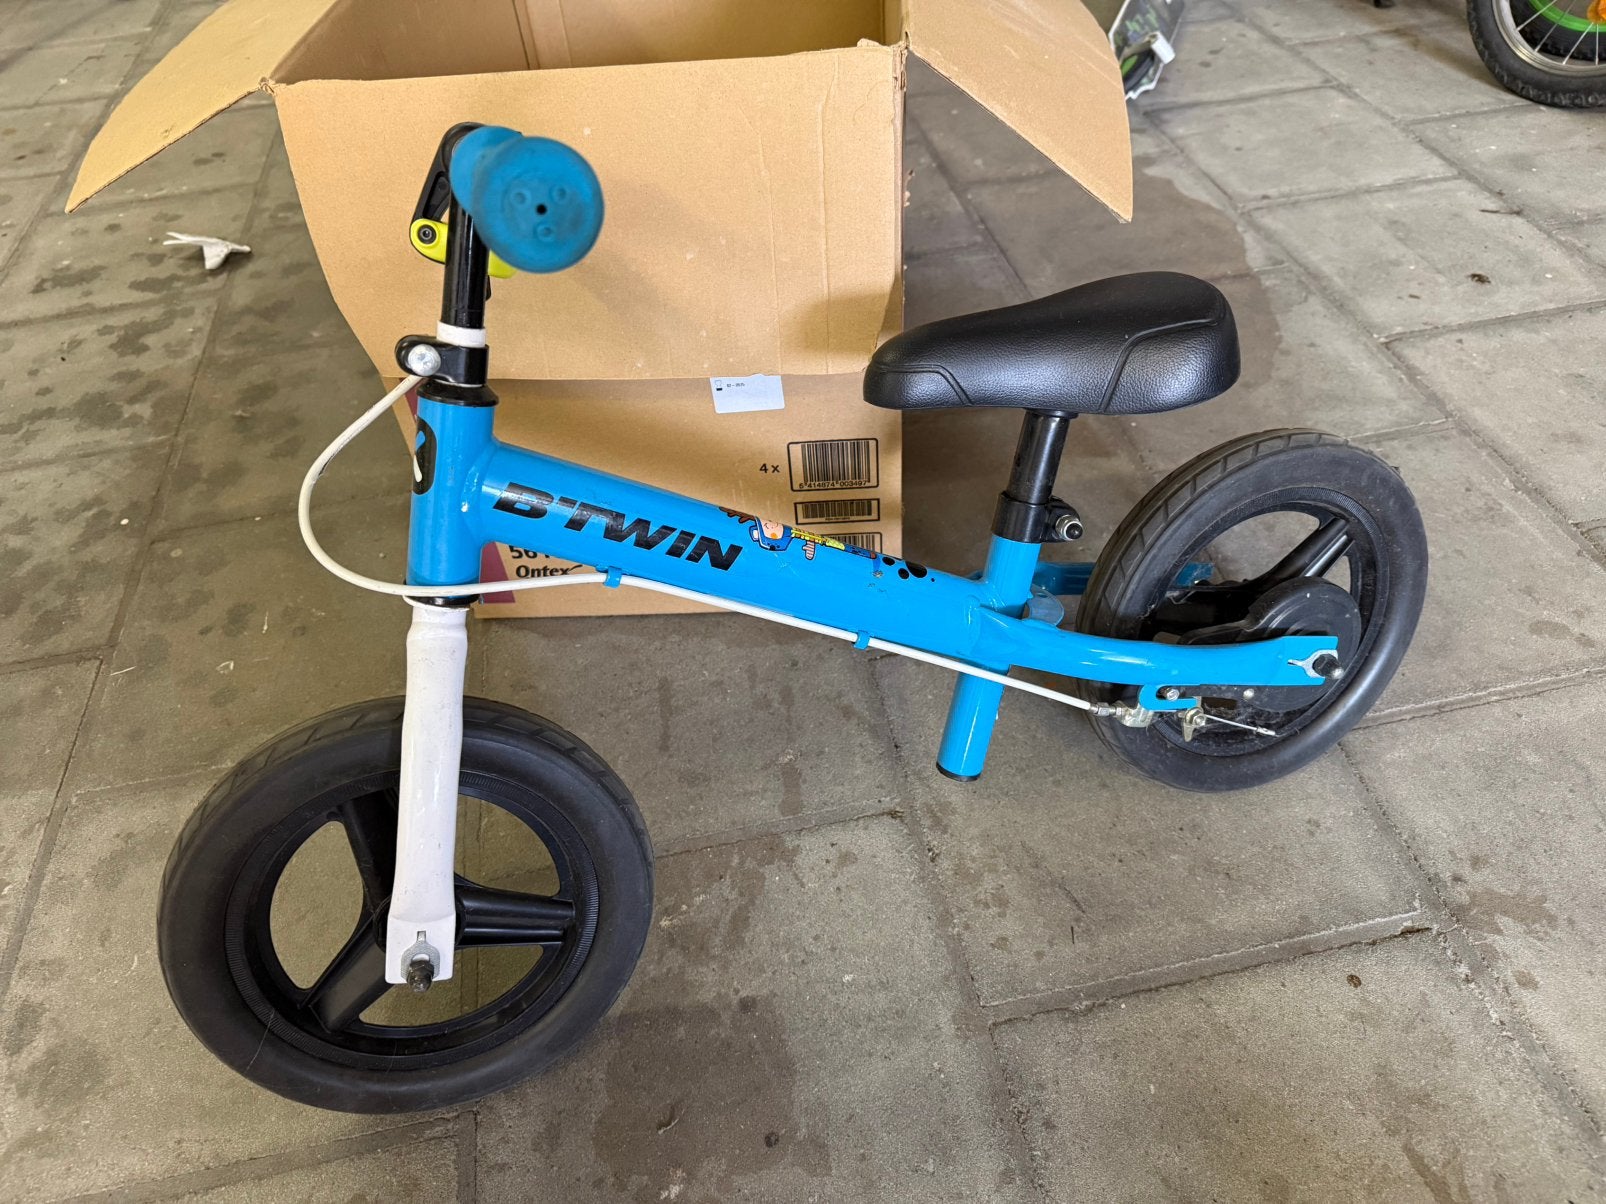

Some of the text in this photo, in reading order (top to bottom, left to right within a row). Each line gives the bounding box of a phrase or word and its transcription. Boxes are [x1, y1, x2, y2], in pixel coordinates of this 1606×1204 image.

[759, 463, 781, 474] 4 x
[515, 564, 573, 579] Ontex
